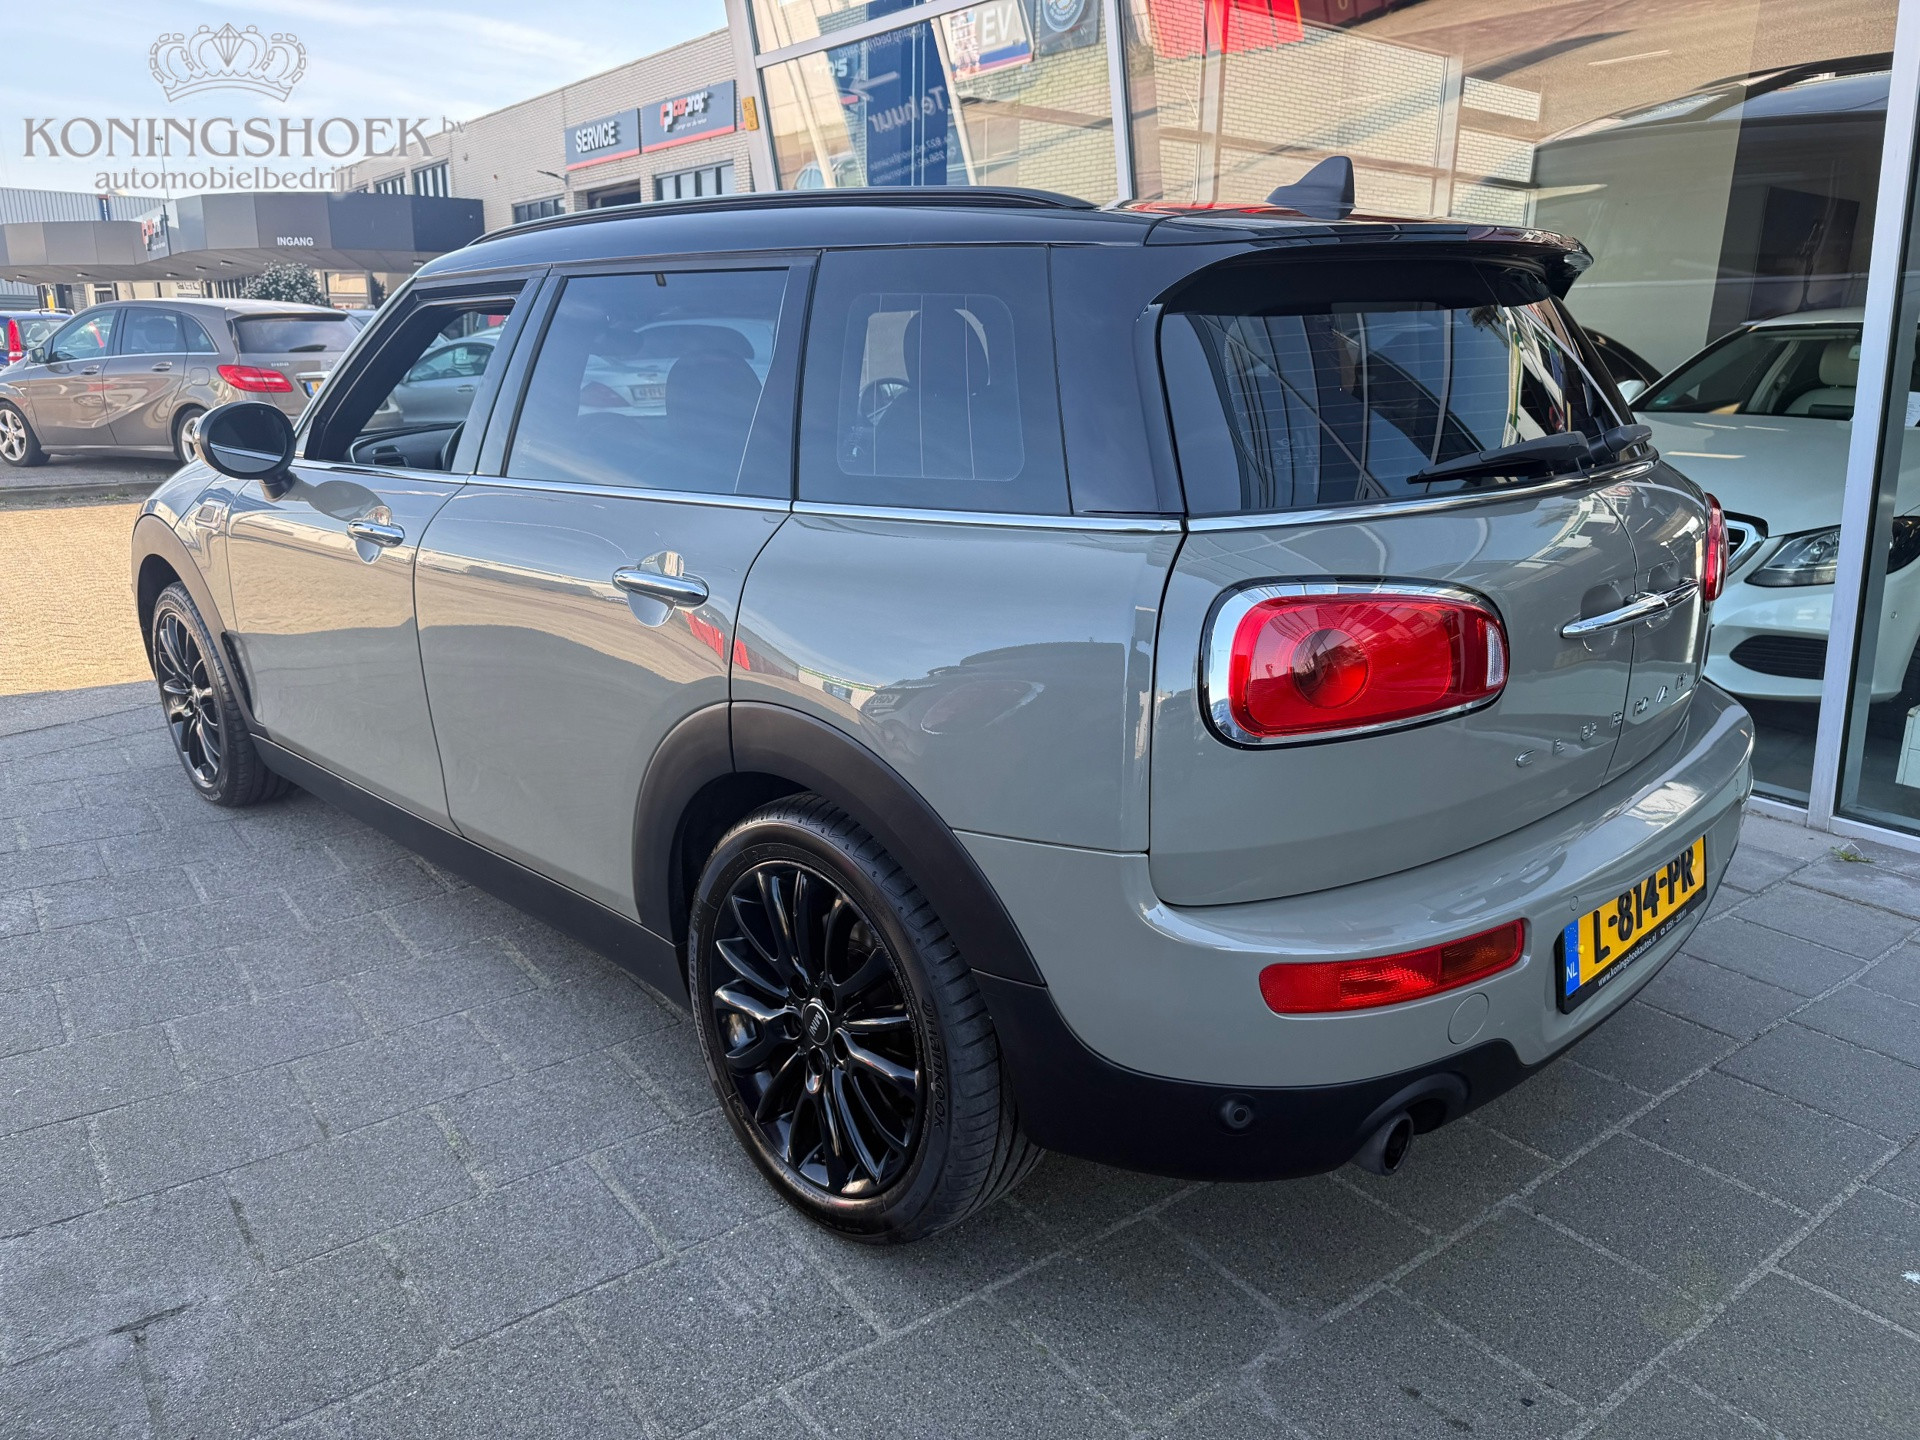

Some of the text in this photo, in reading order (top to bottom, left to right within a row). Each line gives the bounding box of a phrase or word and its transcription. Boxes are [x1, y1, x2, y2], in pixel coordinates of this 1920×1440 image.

[575, 120, 616, 154] SERVICE
[276, 236, 314, 246] INGANG
[1593, 845, 1696, 964] L-814-PR
[1566, 962, 1578, 982] NL
[809, 1010, 823, 1036] MINI
